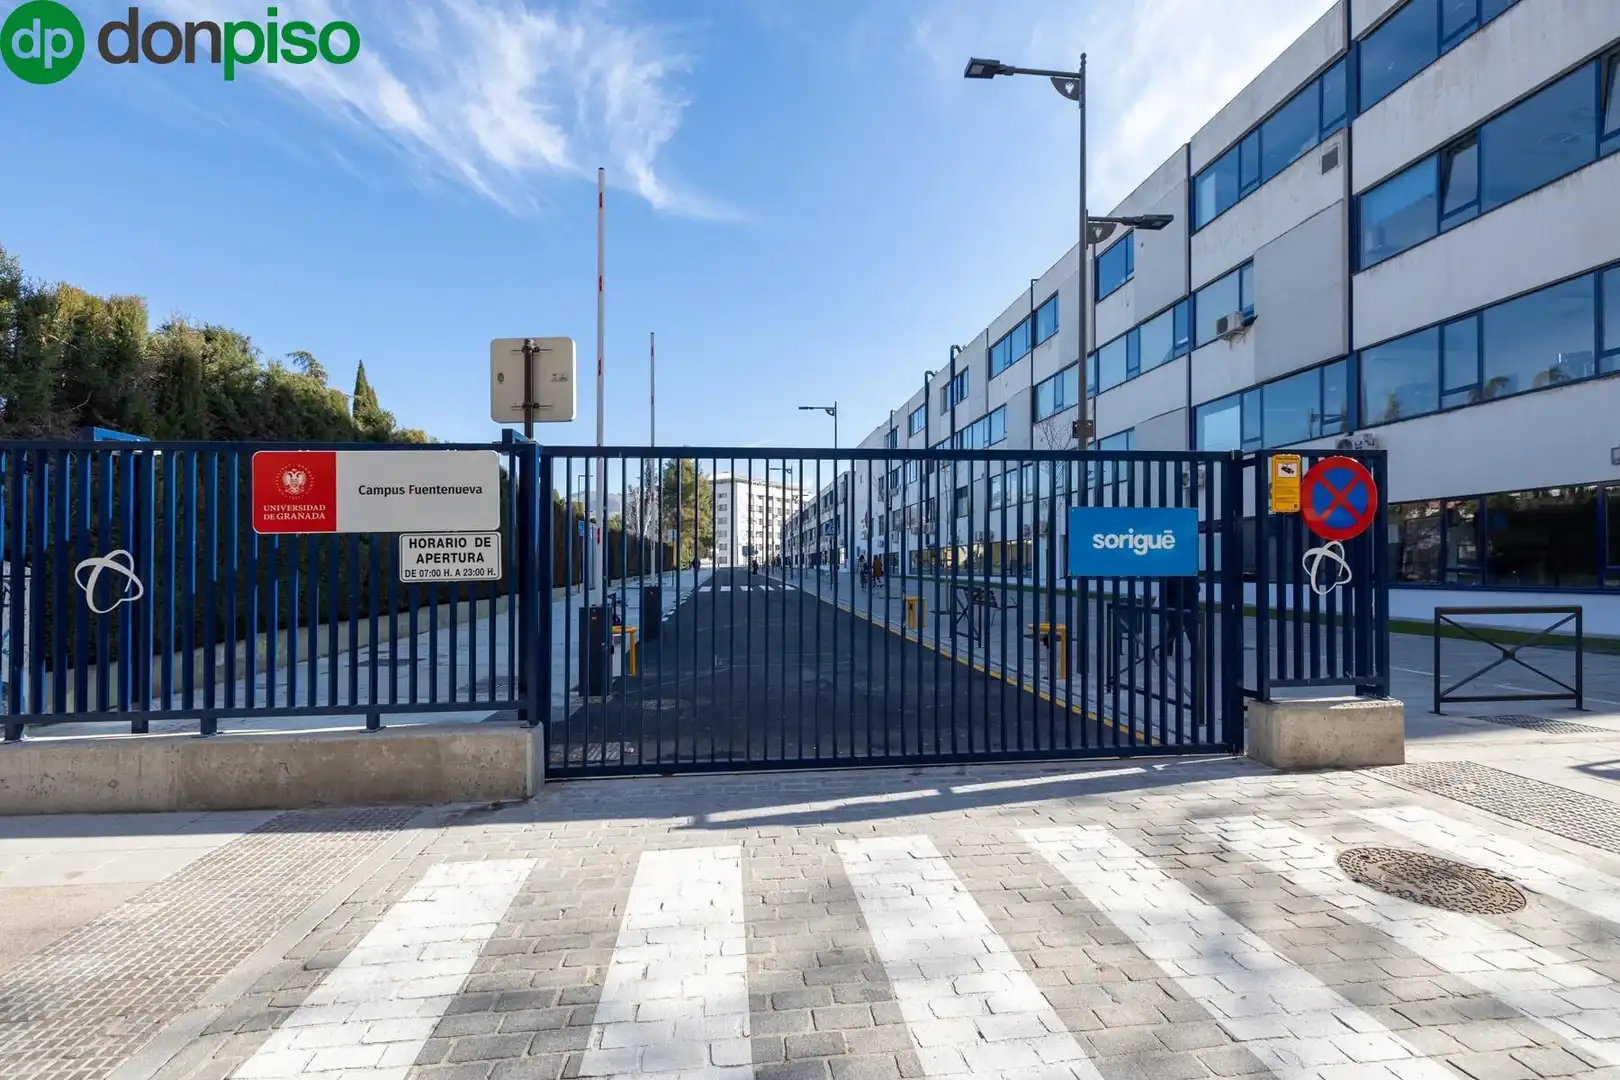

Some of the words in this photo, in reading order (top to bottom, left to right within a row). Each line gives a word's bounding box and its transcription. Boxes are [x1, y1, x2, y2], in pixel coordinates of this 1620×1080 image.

[358, 484, 406, 498] Campus
[408, 484, 483, 495] Fuentenueva
[263, 504, 326, 512] UNIVERSIDAD
[263, 513, 276, 521] DE
[276, 512, 326, 520] GRANADA
[408, 537, 467, 549] HORARIO
[474, 536, 491, 548] DE
[416, 552, 485, 564] APERTURA
[404, 569, 417, 578] DE
[419, 568, 441, 578] 07:00
[443, 568, 453, 577] H.
[455, 568, 461, 577] A
[463, 567, 485, 577] 23:00
[487, 567, 496, 576] H.
